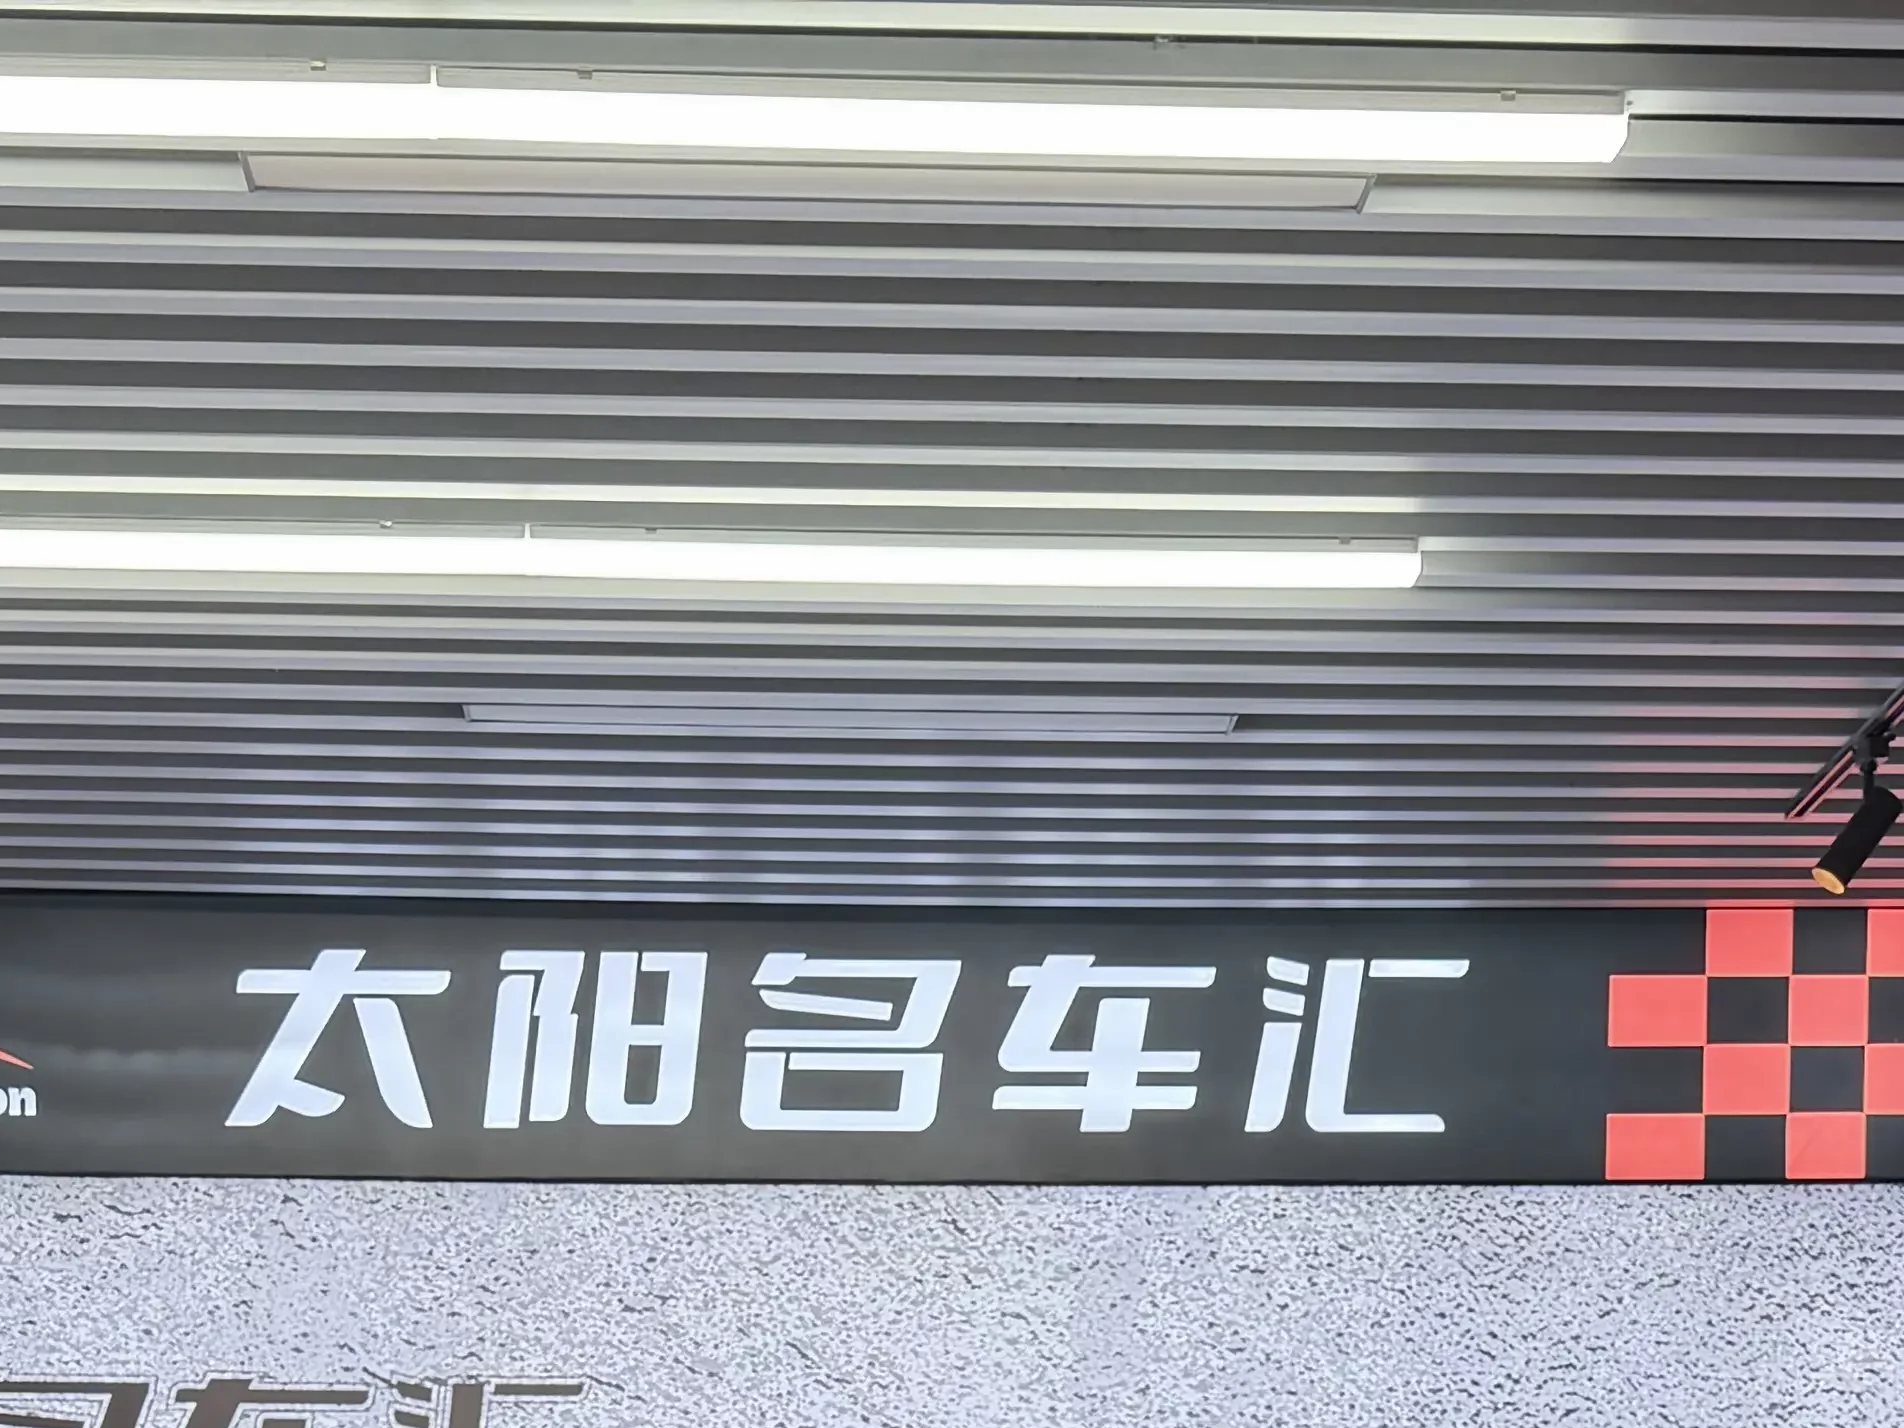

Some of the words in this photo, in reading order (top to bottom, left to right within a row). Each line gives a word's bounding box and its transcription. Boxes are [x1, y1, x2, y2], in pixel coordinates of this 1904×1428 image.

[225, 948, 1470, 1133] 太阳名车汇
